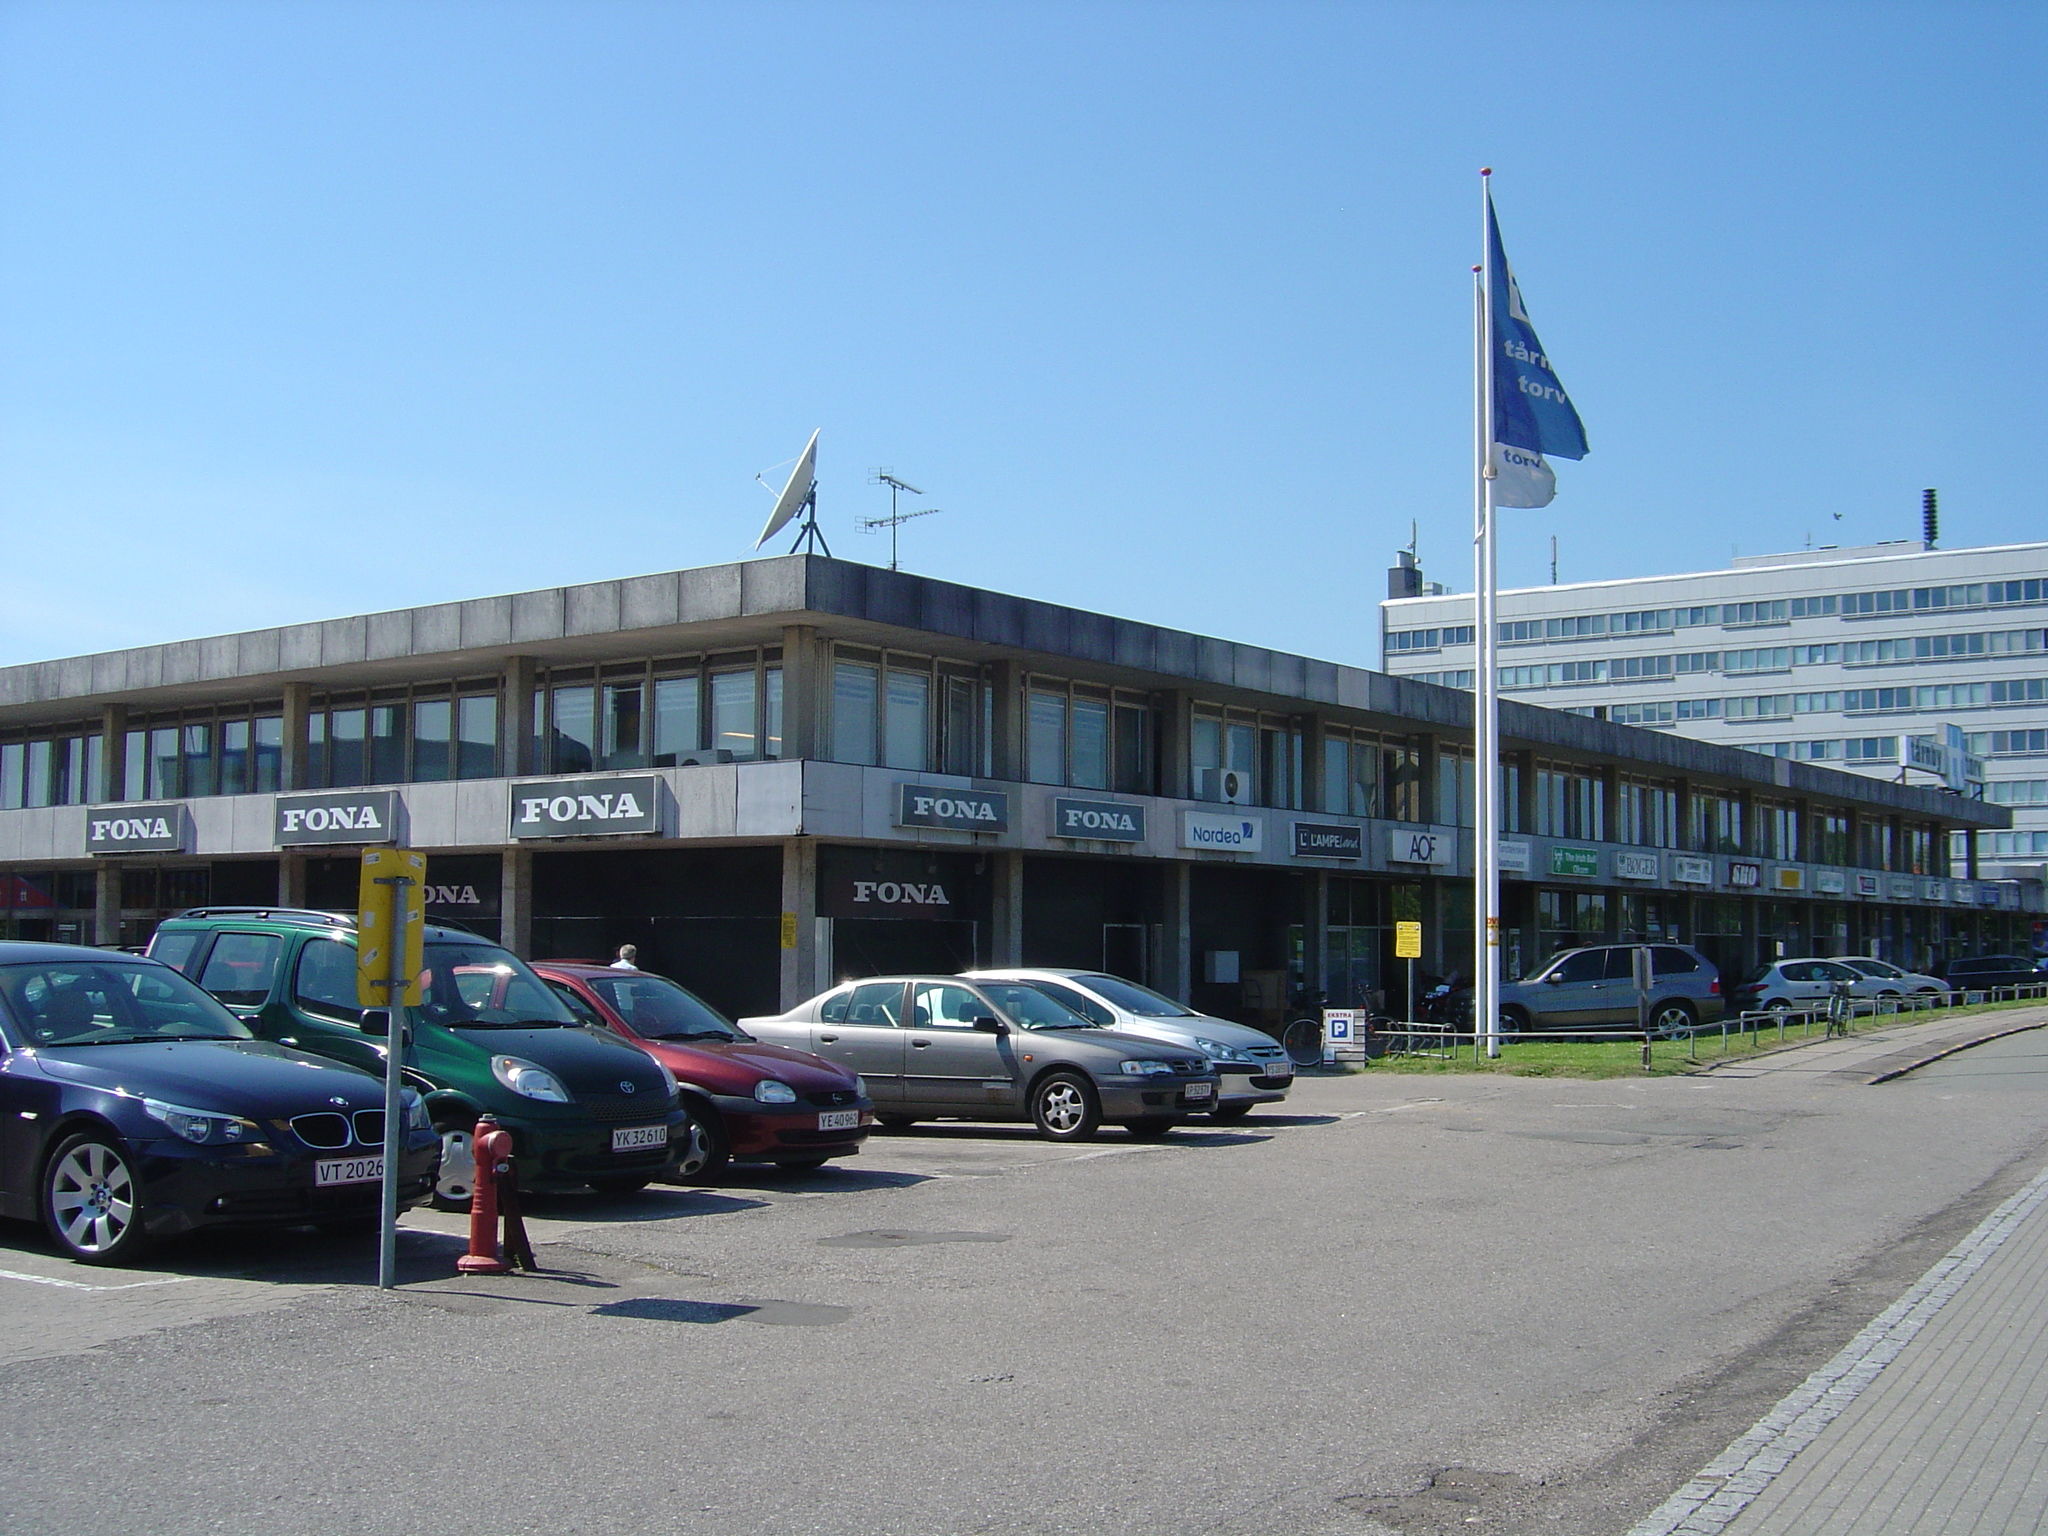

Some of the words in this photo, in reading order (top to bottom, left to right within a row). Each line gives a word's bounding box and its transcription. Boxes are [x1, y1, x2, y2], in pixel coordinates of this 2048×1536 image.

[1518, 375, 1566, 405] torv
[1504, 449, 1541, 468] torv
[520, 793, 644, 823] FONA
[914, 797, 997, 821] FONA
[92, 818, 172, 840] FONA
[283, 806, 382, 832] FONA
[1066, 810, 1136, 831] FONA
[1193, 826, 1241, 844] Nordea
[1410, 835, 1437, 862] AOF
[1626, 857, 1657, 876] BØGER
[424, 885, 480, 904] ONA
[853, 882, 950, 904] FONA
[1334, 1023, 1345, 1036] P
[821, 1115, 833, 1128] YE
[616, 1132, 630, 1146] YK
[632, 1128, 665, 1145] 32610
[320, 1164, 342, 1181] VT
